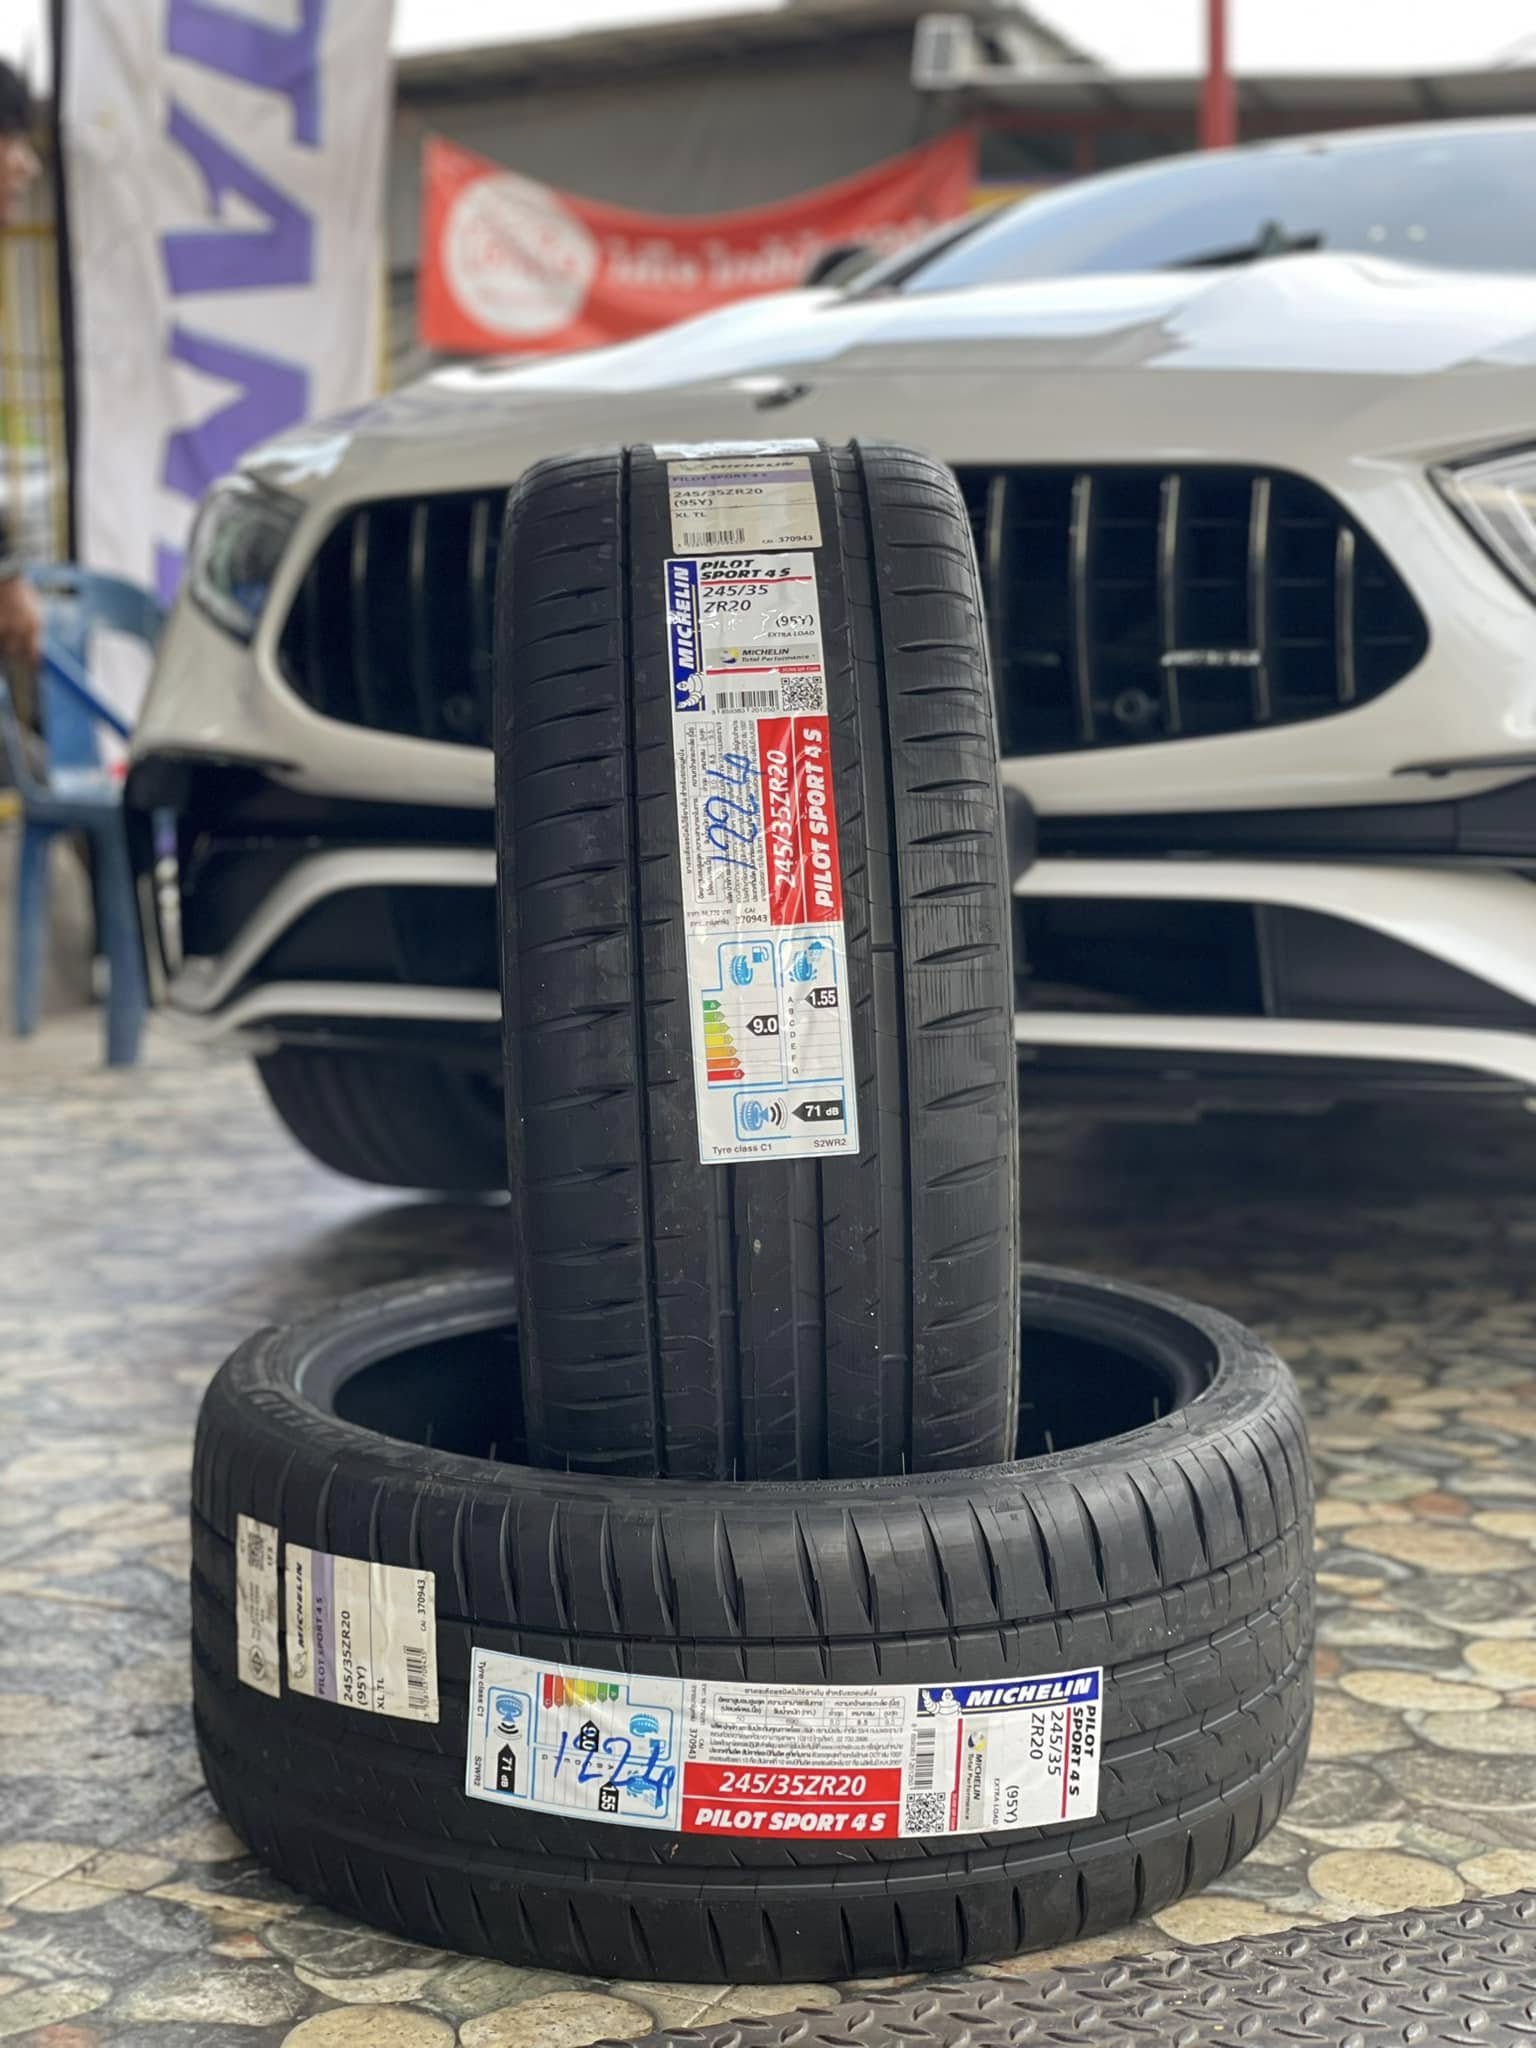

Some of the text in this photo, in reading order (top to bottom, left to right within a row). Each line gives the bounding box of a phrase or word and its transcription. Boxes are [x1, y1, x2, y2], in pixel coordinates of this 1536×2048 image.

[673, 488, 763, 498] 245/35ZR20
[674, 499, 713, 507] (95Y)
[778, 535, 813, 543] 370943
[700, 559, 754, 570] PILOT
[701, 568, 790, 580] SPORT 4 S
[703, 585, 768, 598] 245/35
[704, 600, 751, 613] ZR20
[674, 566, 695, 670] MICHELIN
[775, 615, 814, 628] (95Y)
[742, 648, 789, 656] MICHELIN
[766, 750, 796, 888] 245/35ZR20
[803, 728, 834, 908] PILOT SPORT 4 S
[810, 990, 836, 1006] 1.55
[753, 1018, 777, 1033] 9.0
[805, 1105, 839, 1117] 71 dB
[712, 1143, 772, 1155] Tyre class C1
[814, 1139, 847, 1148] S2WR2
[295, 1562, 303, 1648] MICHELIN
[417, 1579, 426, 1615] 370943
[340, 1610, 353, 1703] 245/35ZR20
[356, 1666, 368, 1706] (95Y)
[376, 1678, 385, 1710] XL TL
[477, 1661, 486, 1717] Tyre class C1
[966, 1677, 1092, 1707] MICHELIN
[582, 1726, 597, 1750] 9.0
[688, 1728, 698, 1760] 370943
[1030, 1713, 1045, 1760] ZR20
[1048, 1711, 1064, 1776] 245/35
[1084, 1705, 1096, 1757] PILOT
[1069, 1707, 1083, 1796] SPORT 4 S
[474, 1755, 482, 1786] S2WR2
[501, 1757, 512, 1787] 71 dB
[719, 1771, 867, 1797] 245/35ZR20
[974, 1754, 983, 1800] MICHELIN
[600, 1784, 616, 1812] 1.55
[1004, 1785, 1020, 1824] (95Y)
[695, 1808, 887, 1832] PILOT SPORT 4 S
